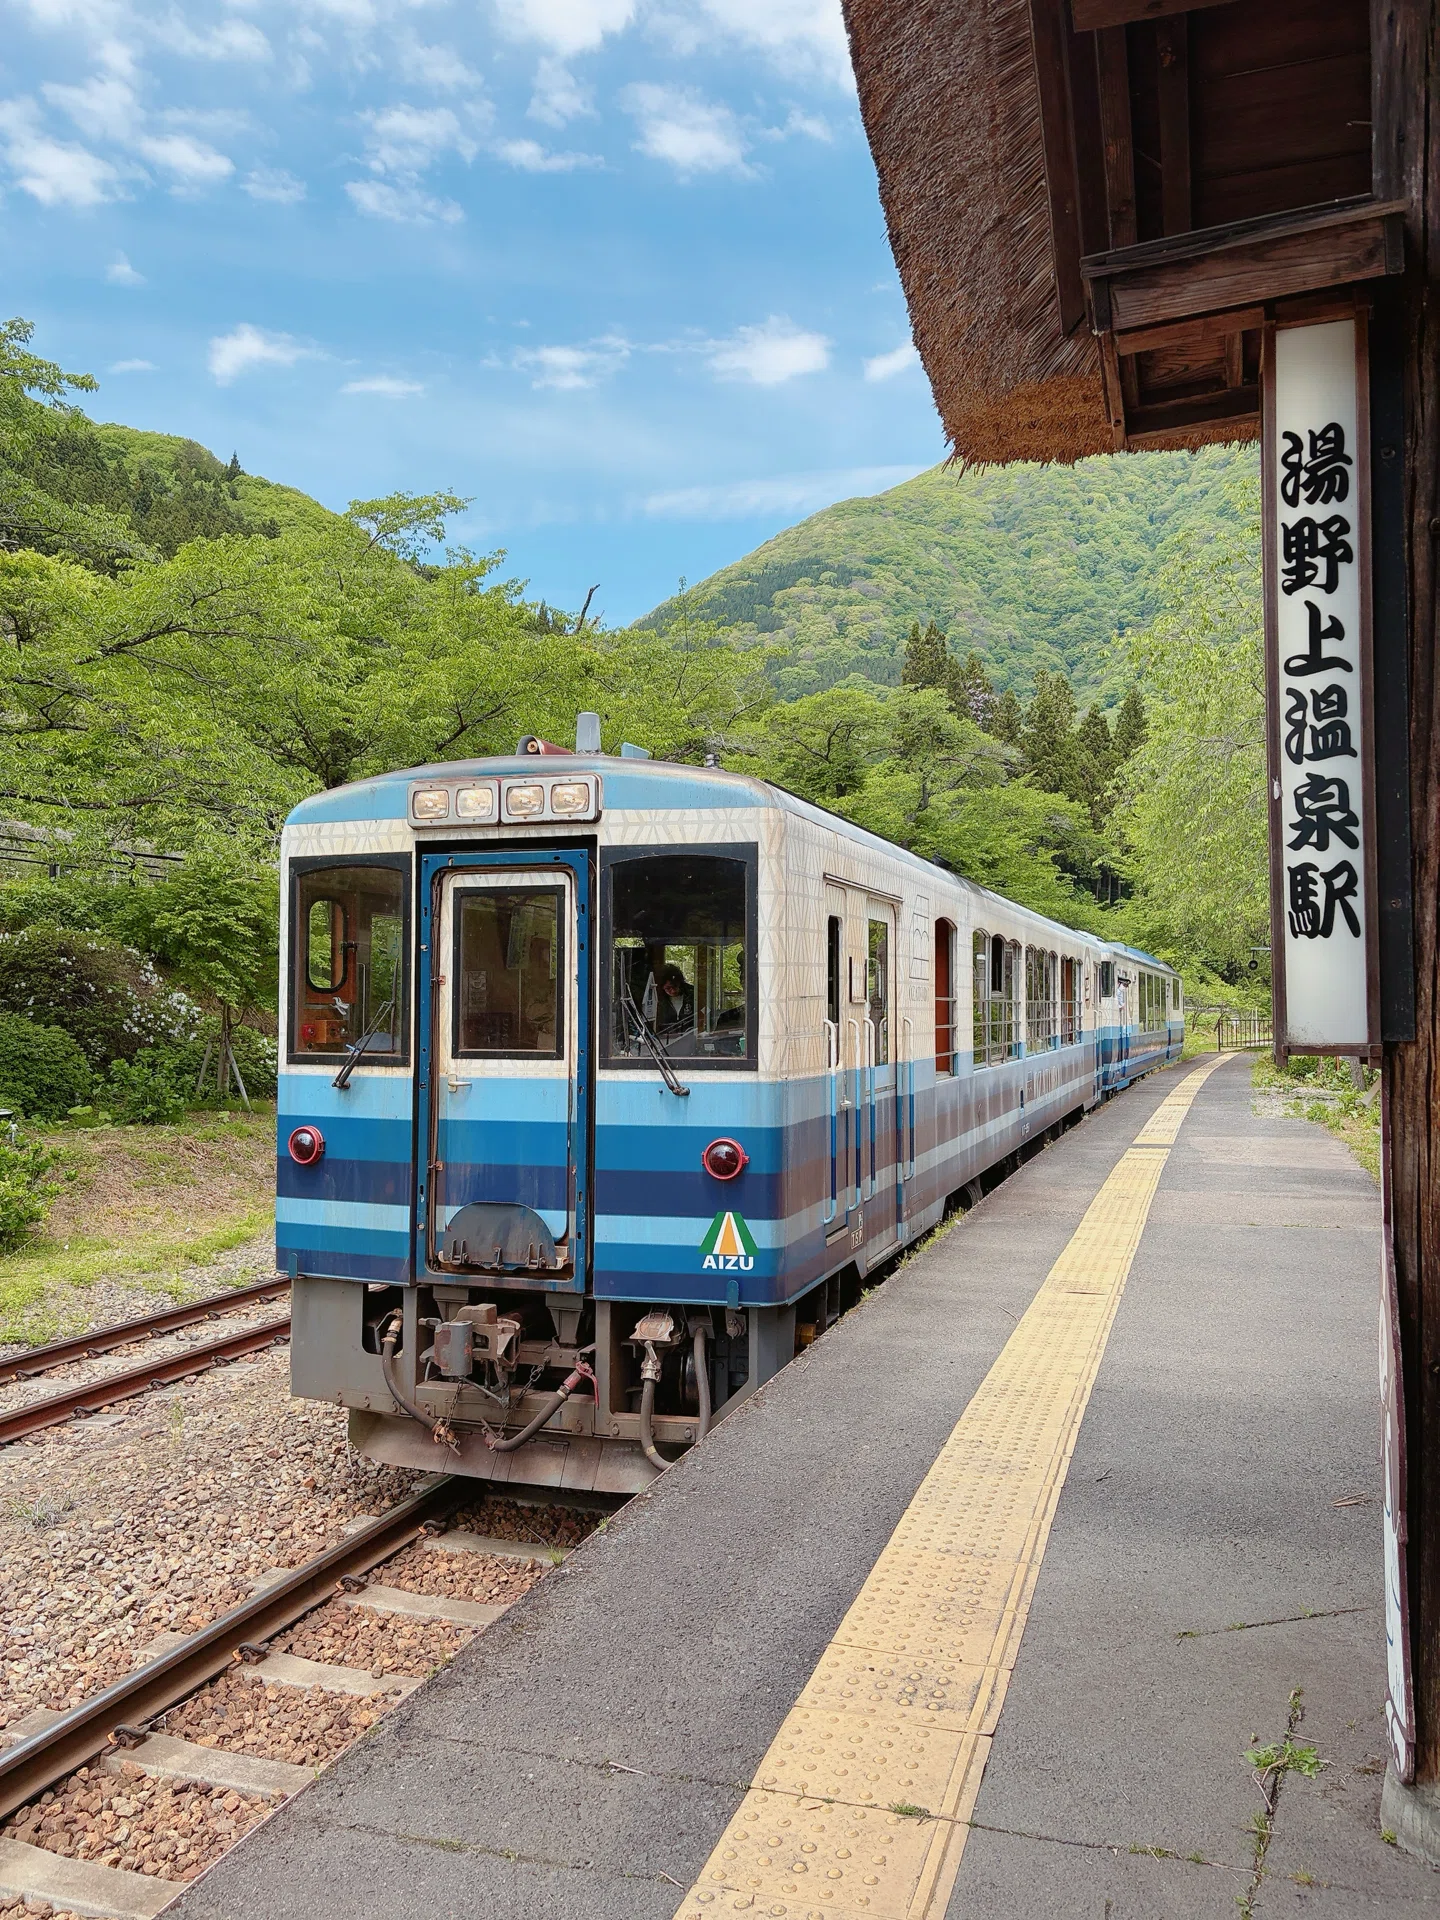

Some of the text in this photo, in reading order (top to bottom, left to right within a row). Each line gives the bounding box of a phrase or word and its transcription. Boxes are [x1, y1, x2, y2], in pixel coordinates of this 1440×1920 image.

[1281, 422, 1361, 939] 湯野上温泉駅
[702, 1255, 754, 1270] AIZU
